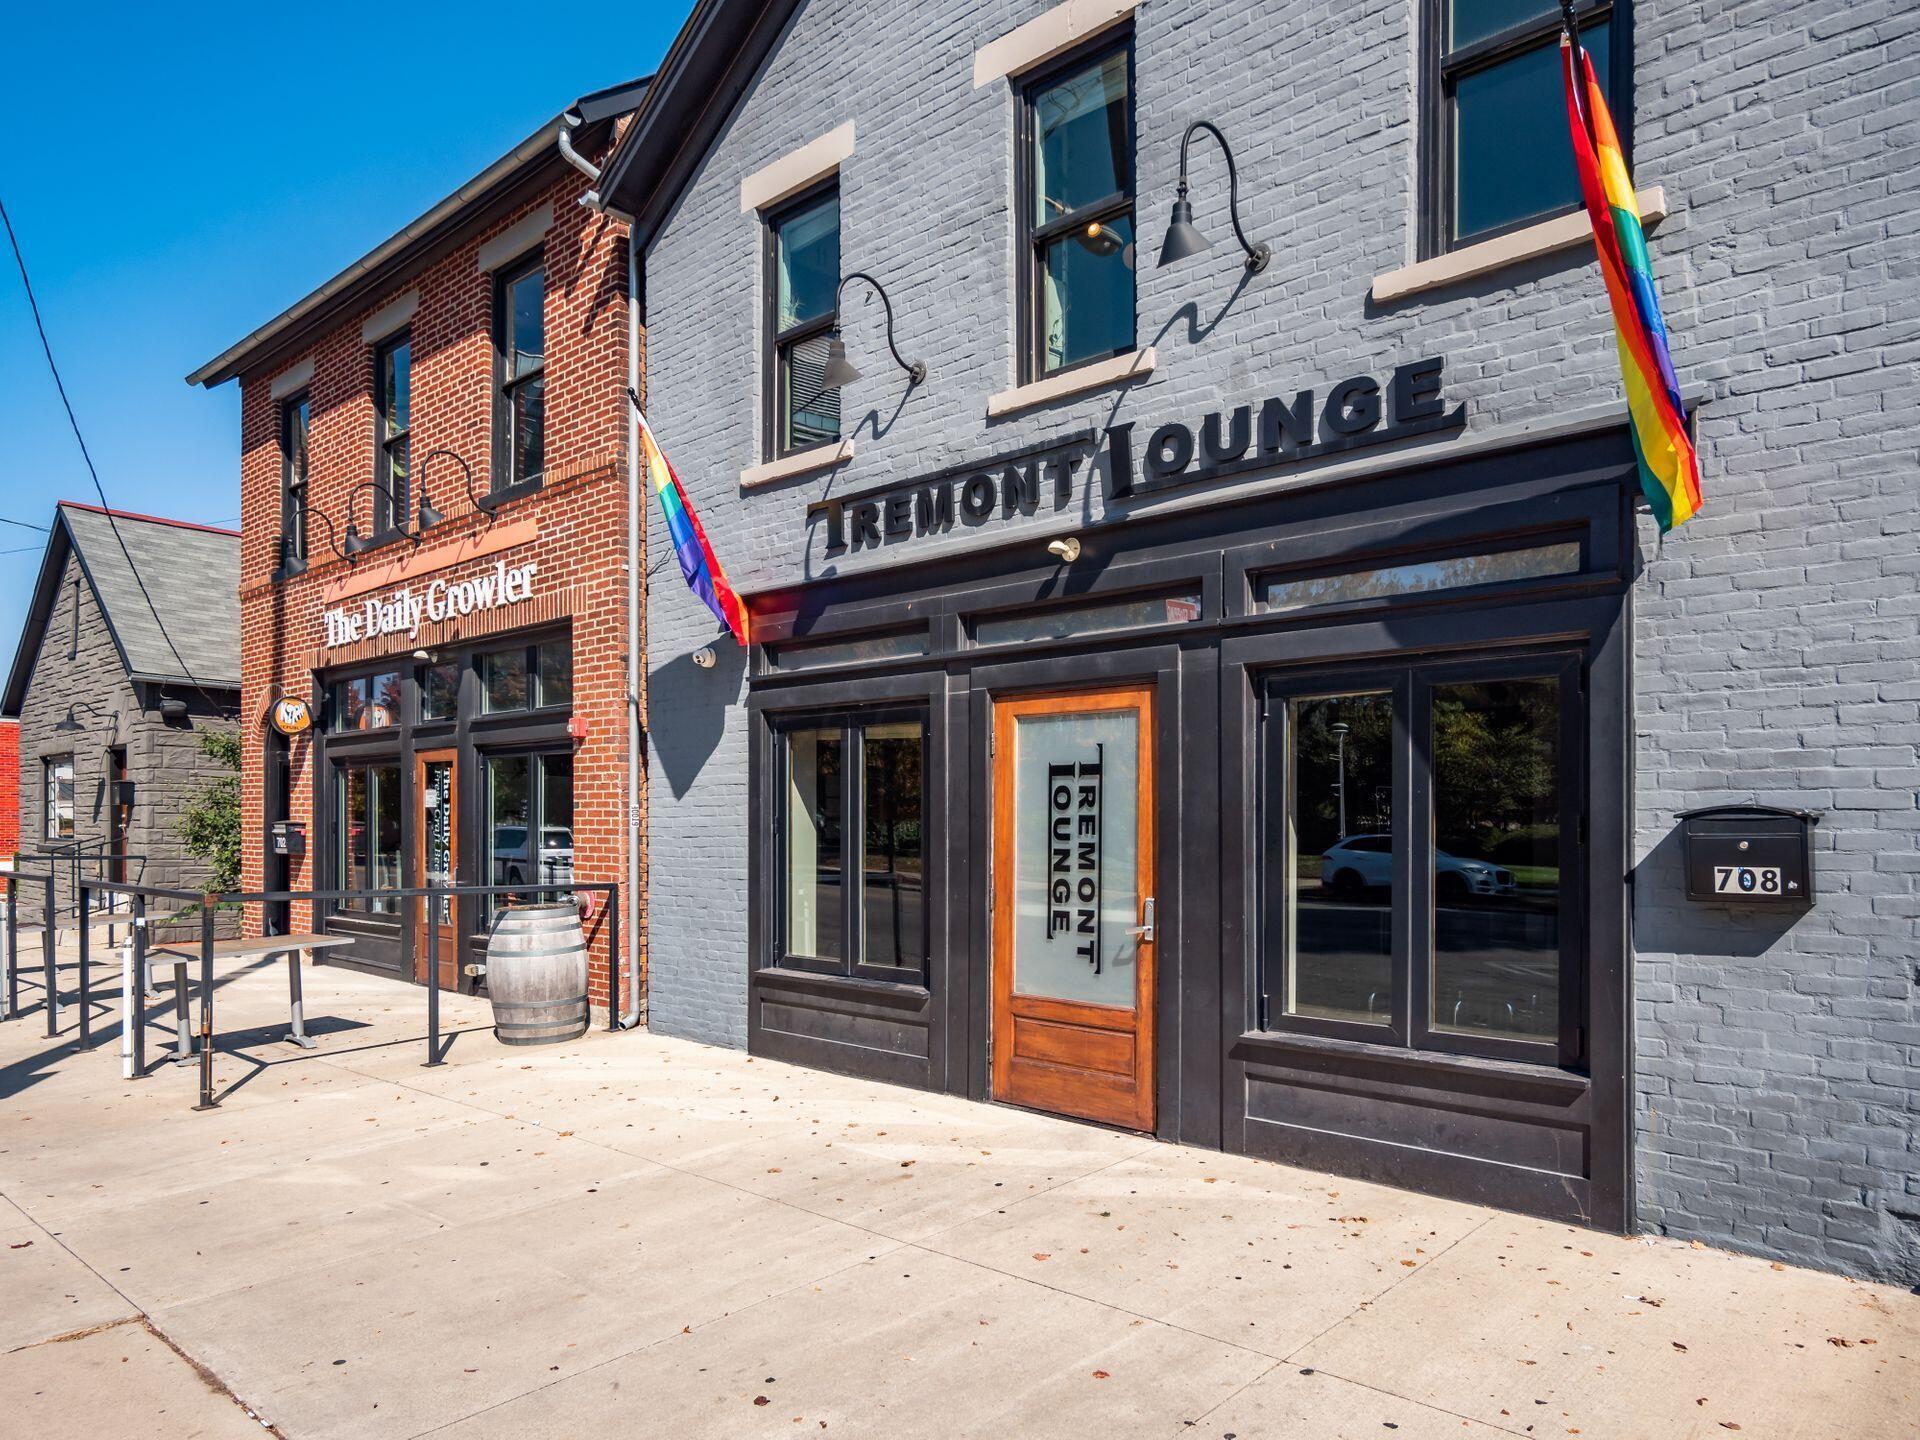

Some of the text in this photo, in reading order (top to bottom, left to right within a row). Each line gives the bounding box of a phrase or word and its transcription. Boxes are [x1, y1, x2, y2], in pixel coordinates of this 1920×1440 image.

[807, 356, 1467, 549] TREMONT LOUNGE
[323, 560, 538, 648] The Daily Growler
[442, 803, 450, 846] Daily
[1047, 761, 1076, 940] LOUNGE
[1077, 743, 1103, 975] TREMONT
[1716, 868, 1778, 892] 708
